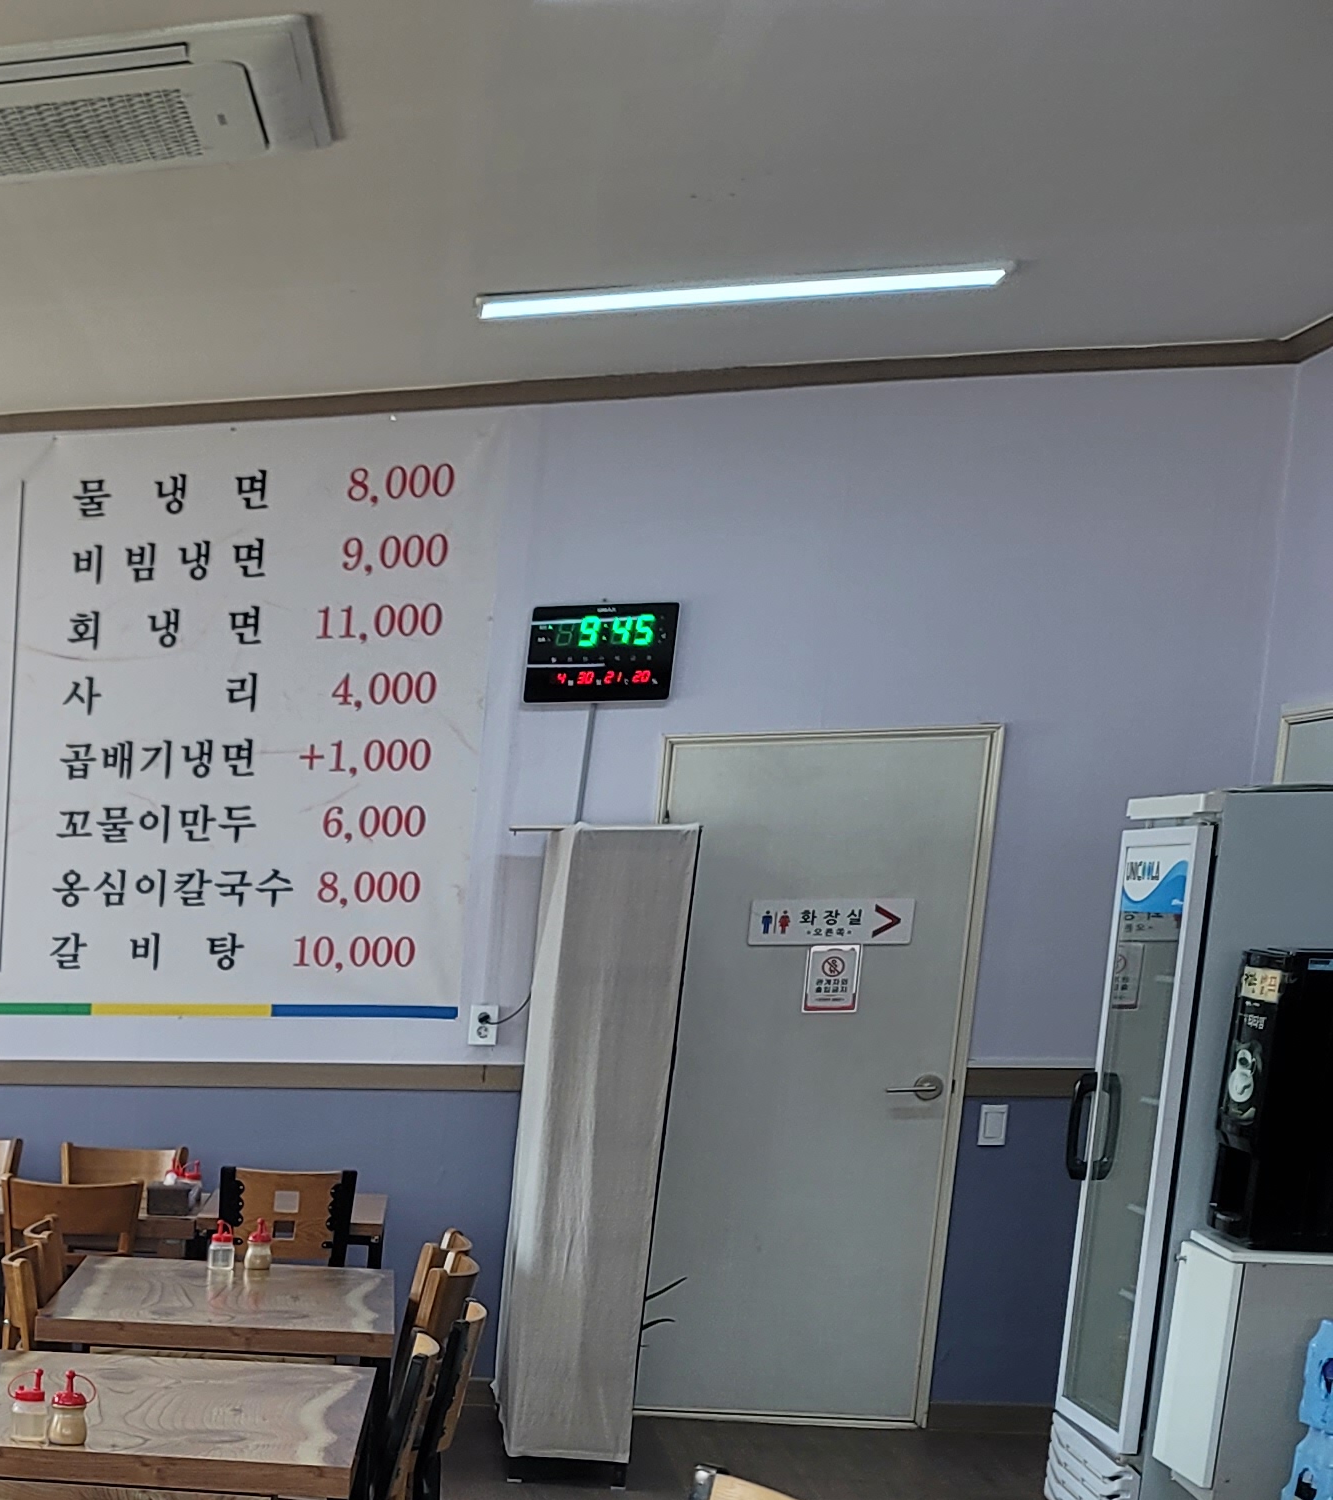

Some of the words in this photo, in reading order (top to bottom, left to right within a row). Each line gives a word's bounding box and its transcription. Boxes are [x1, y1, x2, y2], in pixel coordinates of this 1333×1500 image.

[347, 463, 455, 505] 8,000
[73, 537, 266, 585] 비빔냉면
[342, 533, 449, 575] 9,000
[316, 602, 443, 642] 11,000
[331, 671, 437, 711] 4,000
[59, 738, 255, 780] 곱배기냉면
[299, 738, 432, 777] +1,000
[56, 803, 257, 844] 꼬물이만두
[322, 805, 426, 844] 6,000
[52, 868, 294, 908] 옹심이칼국수
[317, 871, 421, 908] 8,000
[799, 908, 863, 926] 화장실
[293, 935, 416, 973] 10,000
